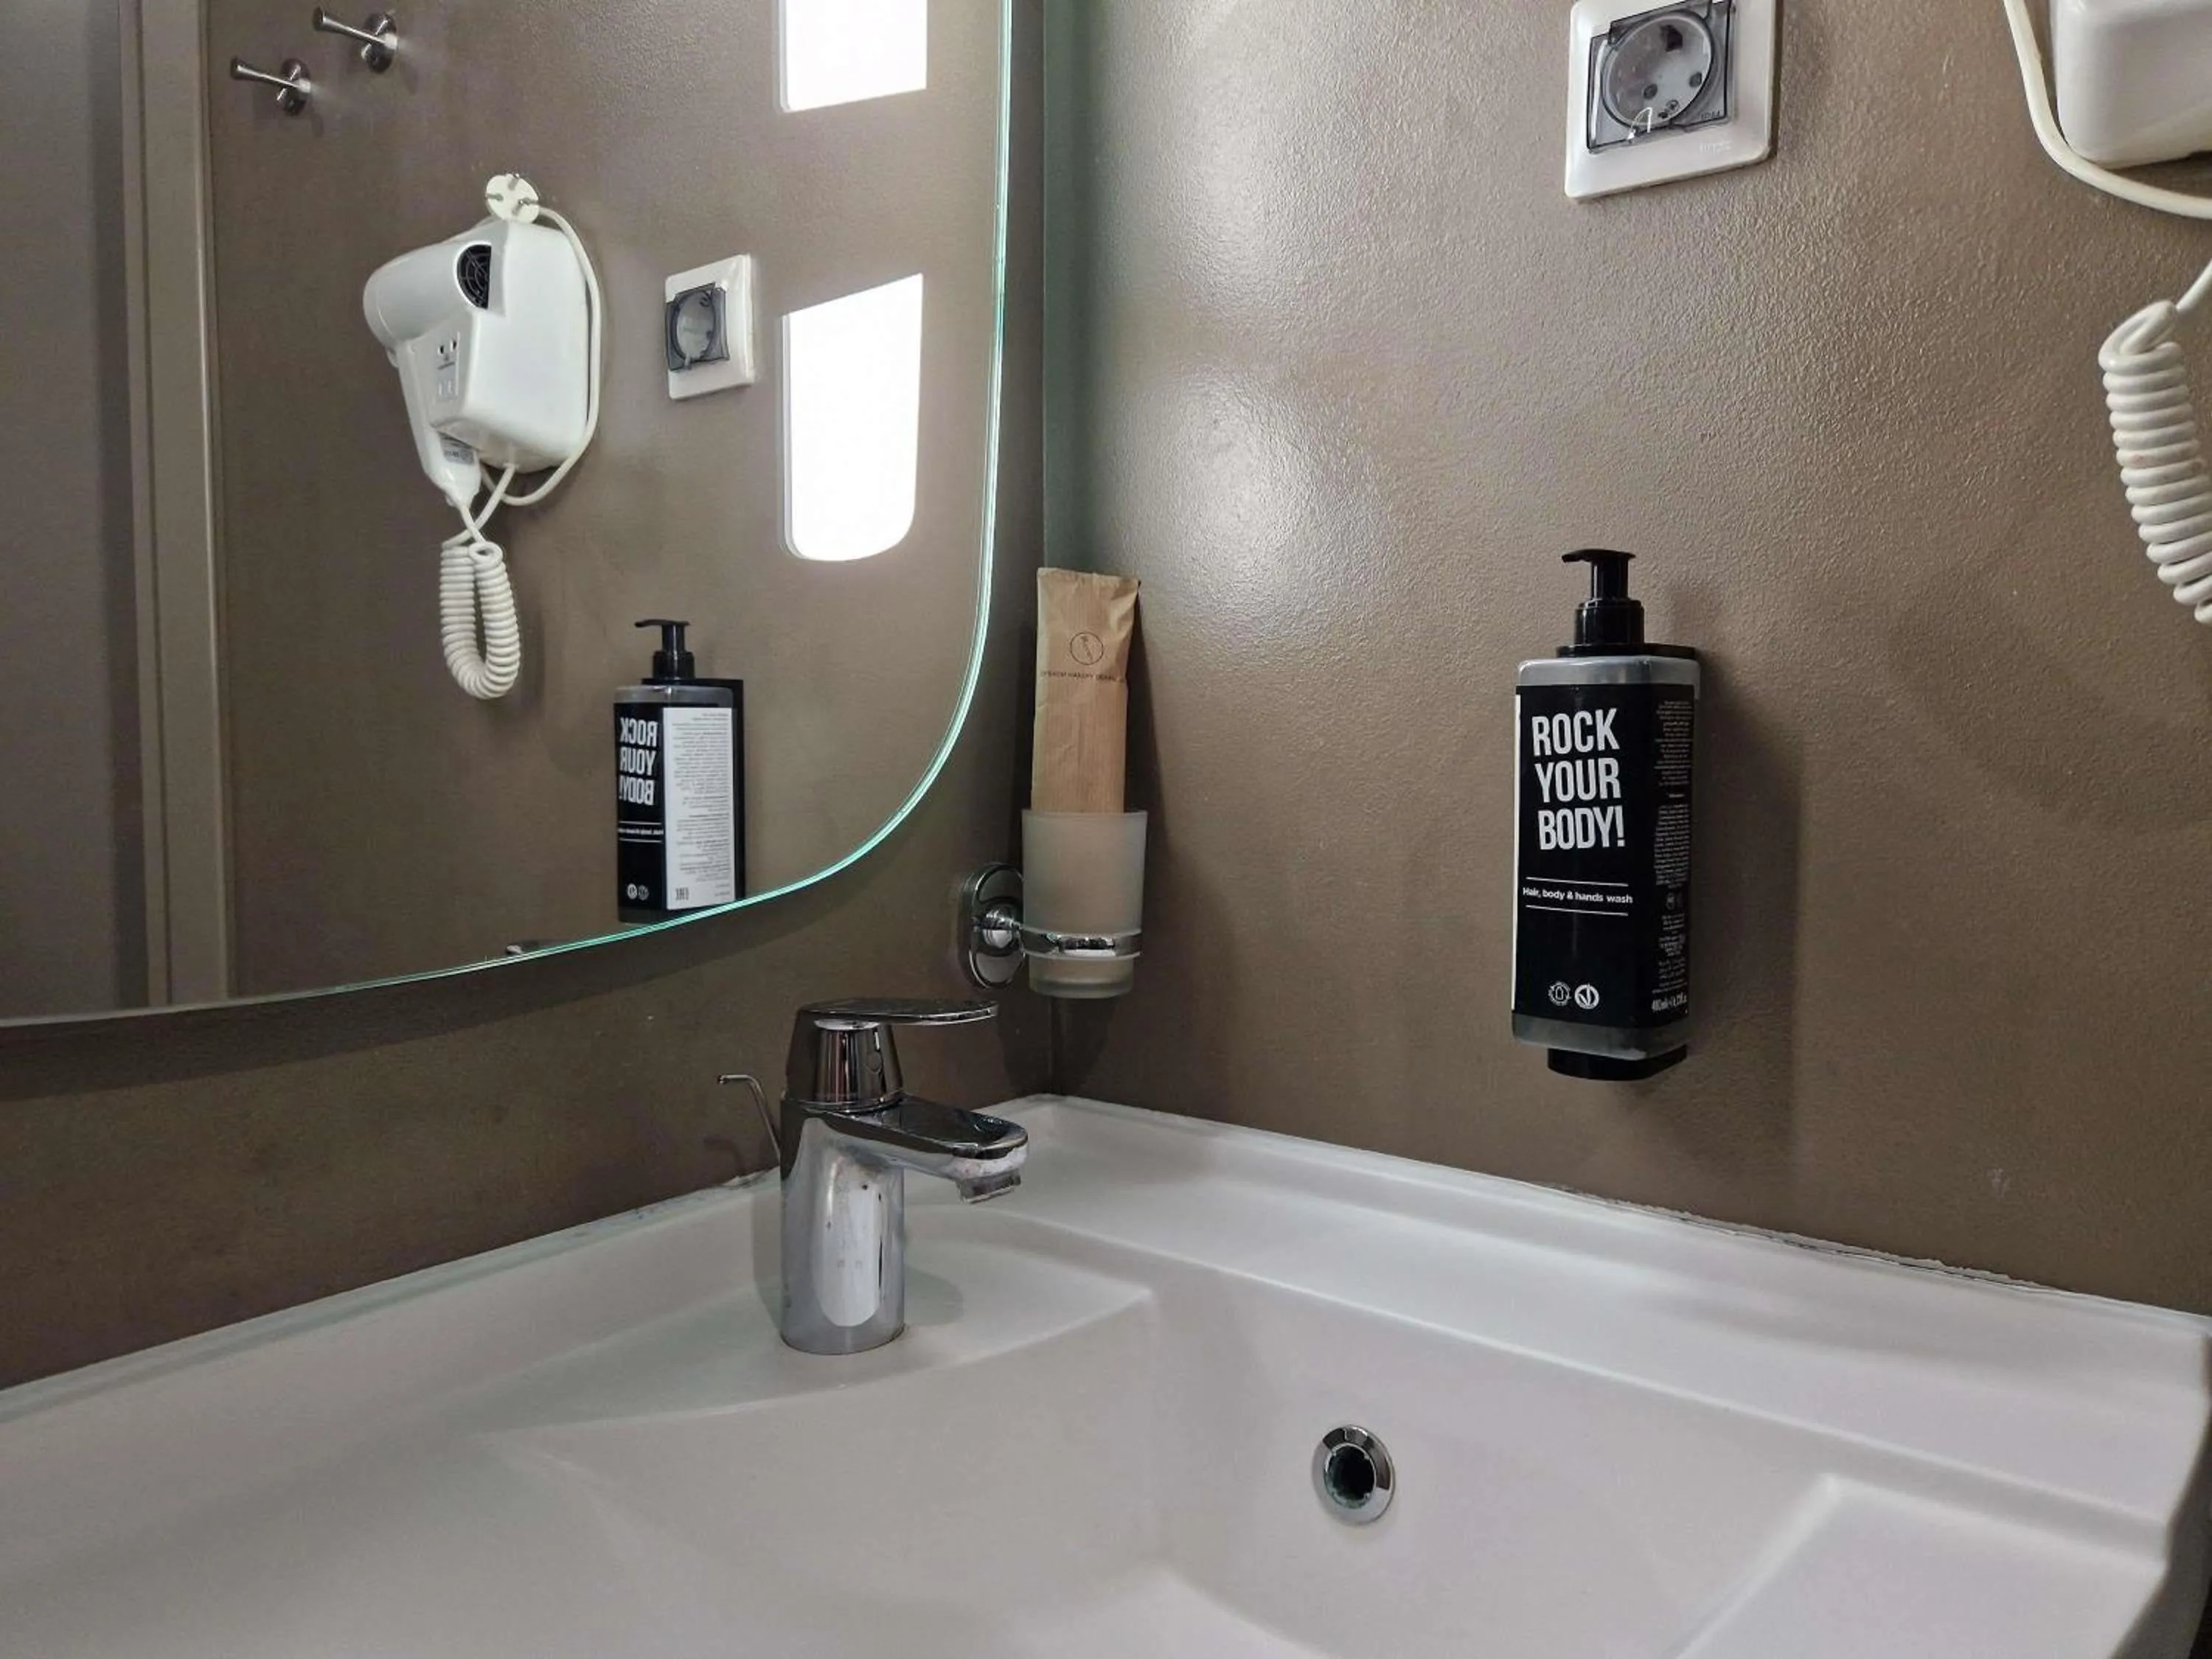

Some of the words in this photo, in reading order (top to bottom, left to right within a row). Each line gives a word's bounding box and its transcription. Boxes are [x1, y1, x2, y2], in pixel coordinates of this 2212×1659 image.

[1531, 708, 1620, 757] ROCK
[1534, 757, 1621, 803] YOUR
[1537, 805, 1625, 850] BODY!
[1523, 887, 1541, 898] Hair,
[1543, 889, 1565, 900] body
[1567, 890, 1573, 900] &
[1575, 891, 1604, 902] hands
[1607, 894, 1633, 903] wash
